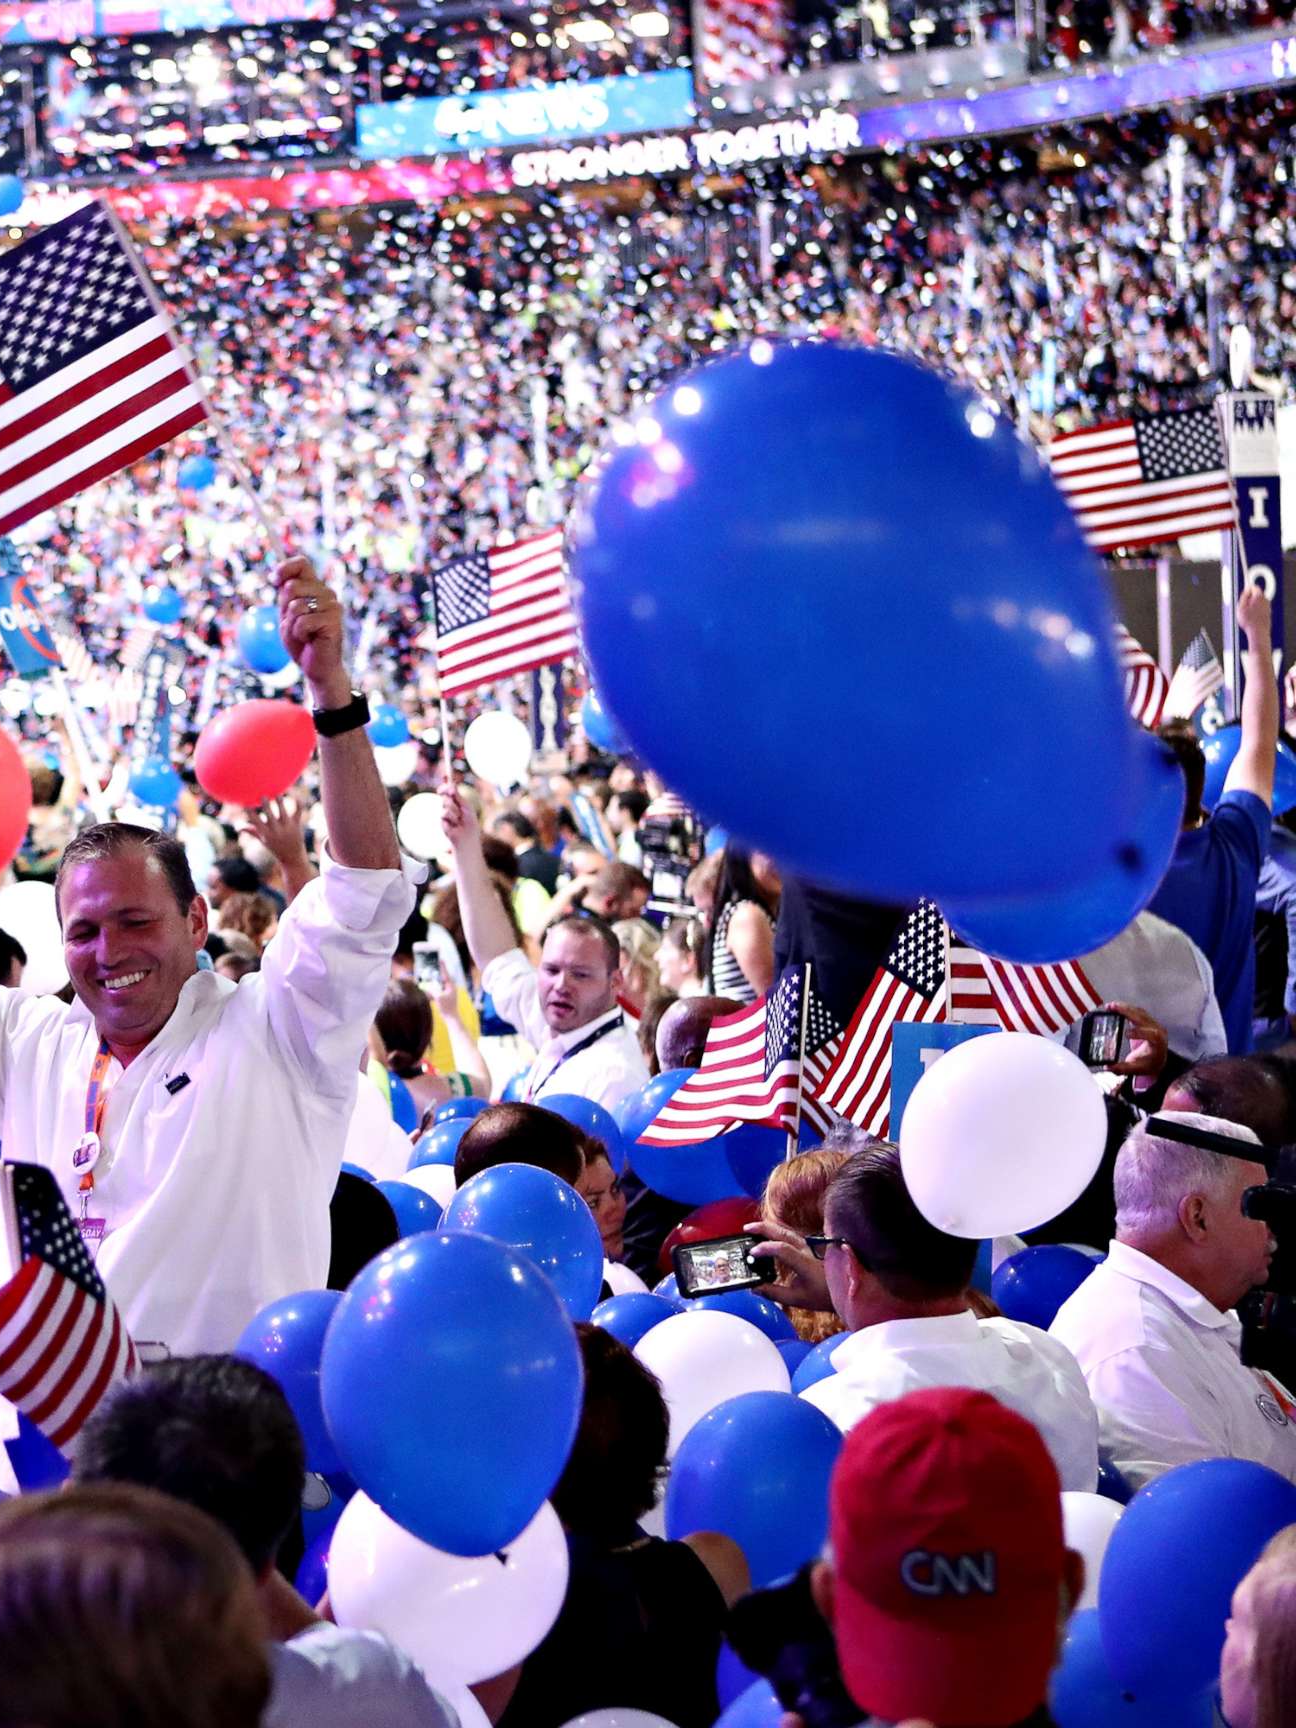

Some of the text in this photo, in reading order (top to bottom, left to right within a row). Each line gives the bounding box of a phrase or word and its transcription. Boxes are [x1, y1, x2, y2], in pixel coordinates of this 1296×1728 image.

[512, 113, 861, 187] STRONGER TOGETHER
[901, 1551, 995, 1595] CNN
